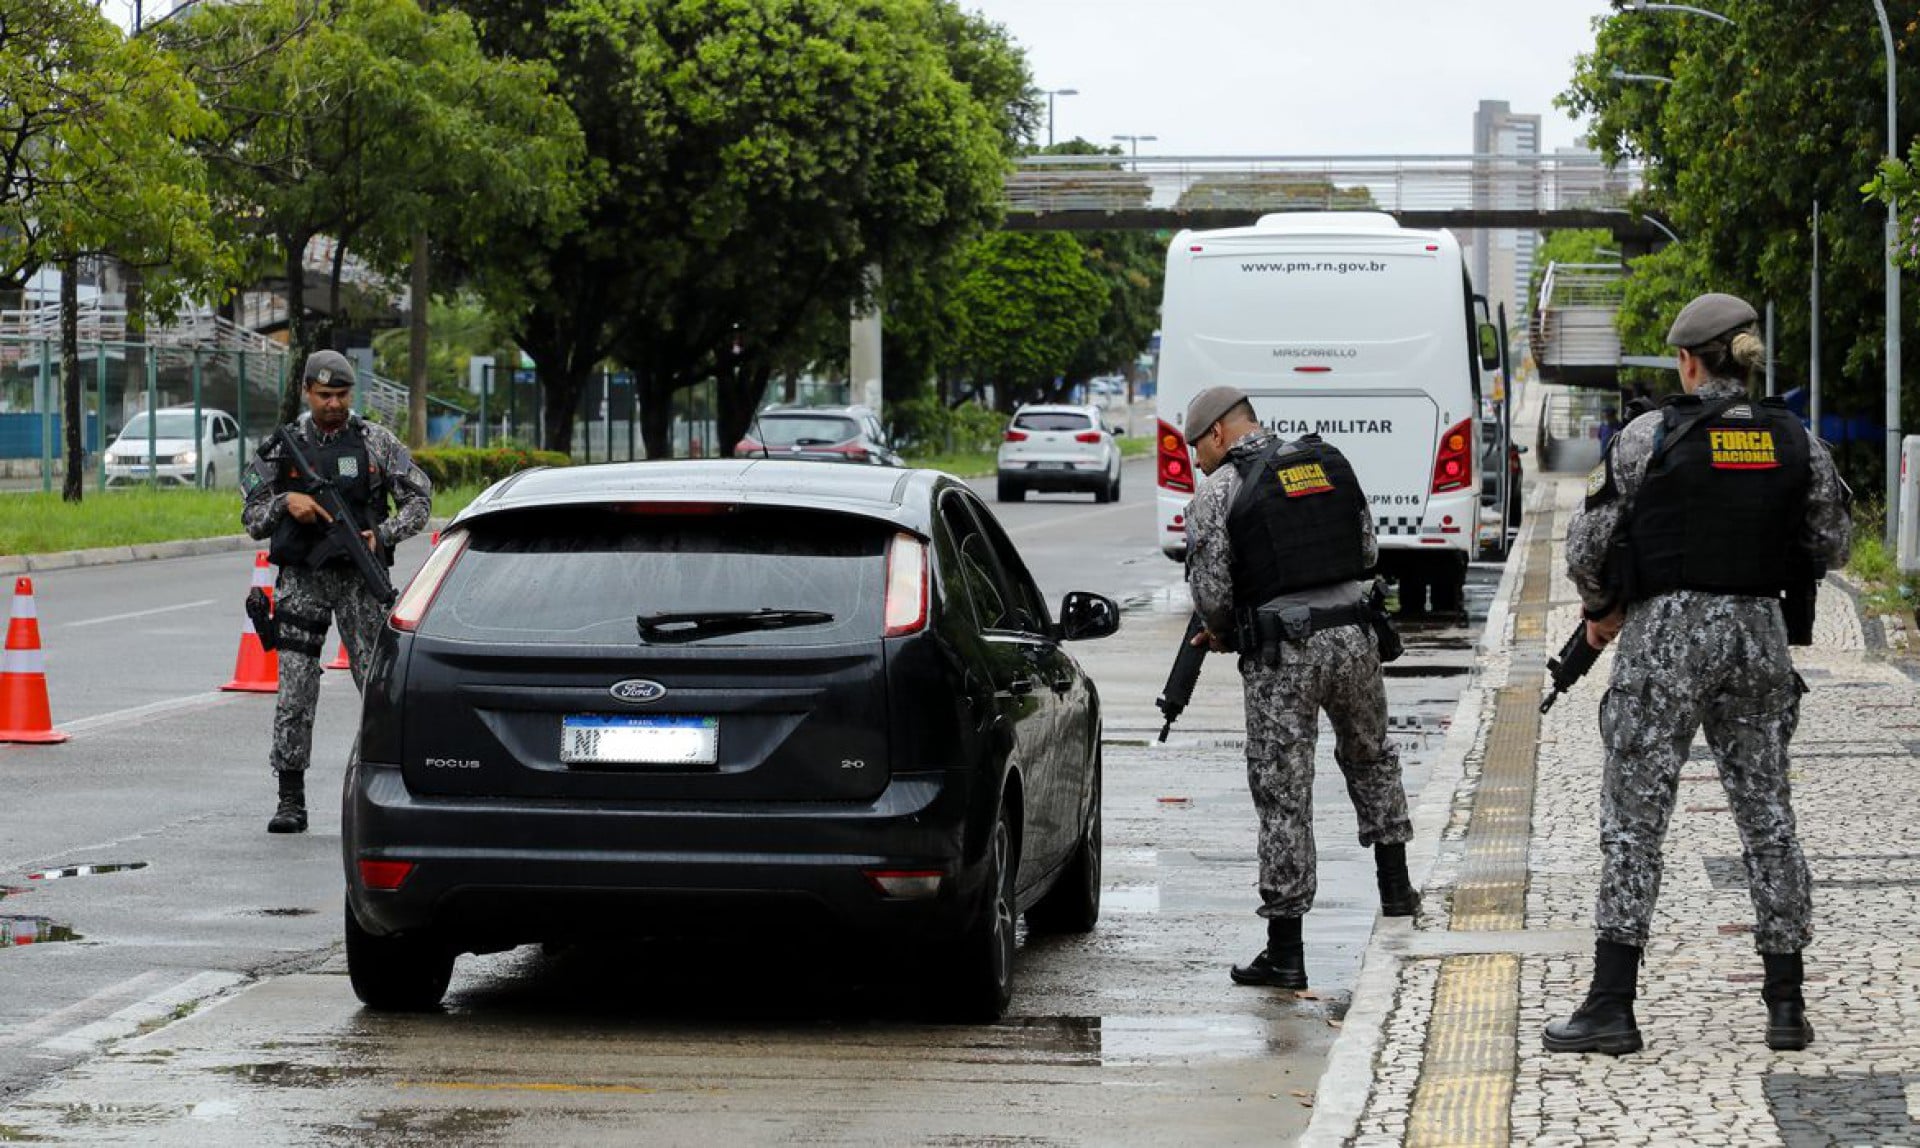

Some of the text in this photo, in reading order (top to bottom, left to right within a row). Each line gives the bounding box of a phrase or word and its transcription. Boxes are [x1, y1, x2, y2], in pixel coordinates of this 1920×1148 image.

[1241, 260, 1387, 274] www.pm.rn.gov.br
[1260, 416, 1393, 434] ÍCIA MILITAR
[1712, 450, 1776, 462] NACIONAL
[1394, 494, 1420, 505] 016
[621, 683, 653, 697] Ford
[425, 758, 480, 769] FOCUS
